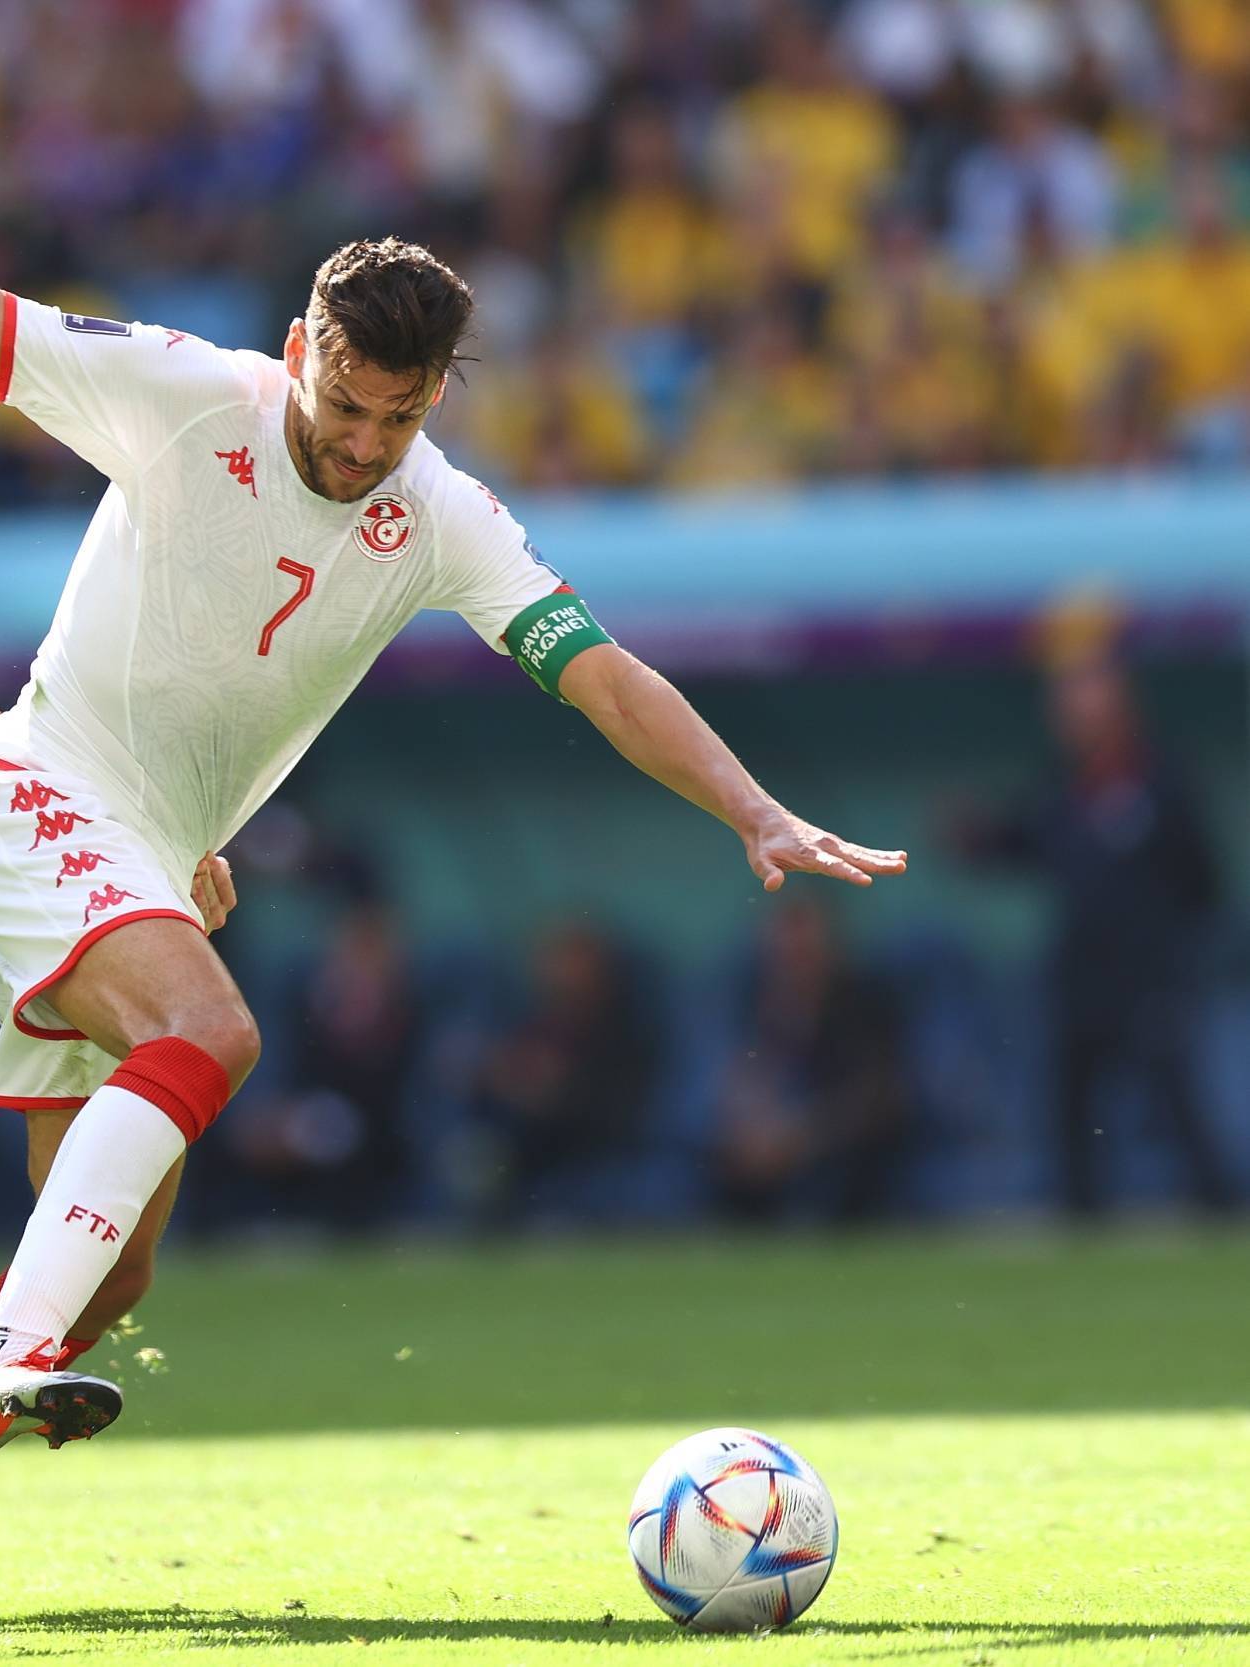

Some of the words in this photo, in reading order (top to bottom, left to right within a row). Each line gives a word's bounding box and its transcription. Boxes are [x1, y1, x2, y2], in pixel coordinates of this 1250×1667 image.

[257, 556, 316, 656] 7
[520, 618, 551, 659] SAVE
[547, 606, 581, 622] THE
[530, 616, 590, 670] PLANET
[64, 1204, 120, 1242] FTF
